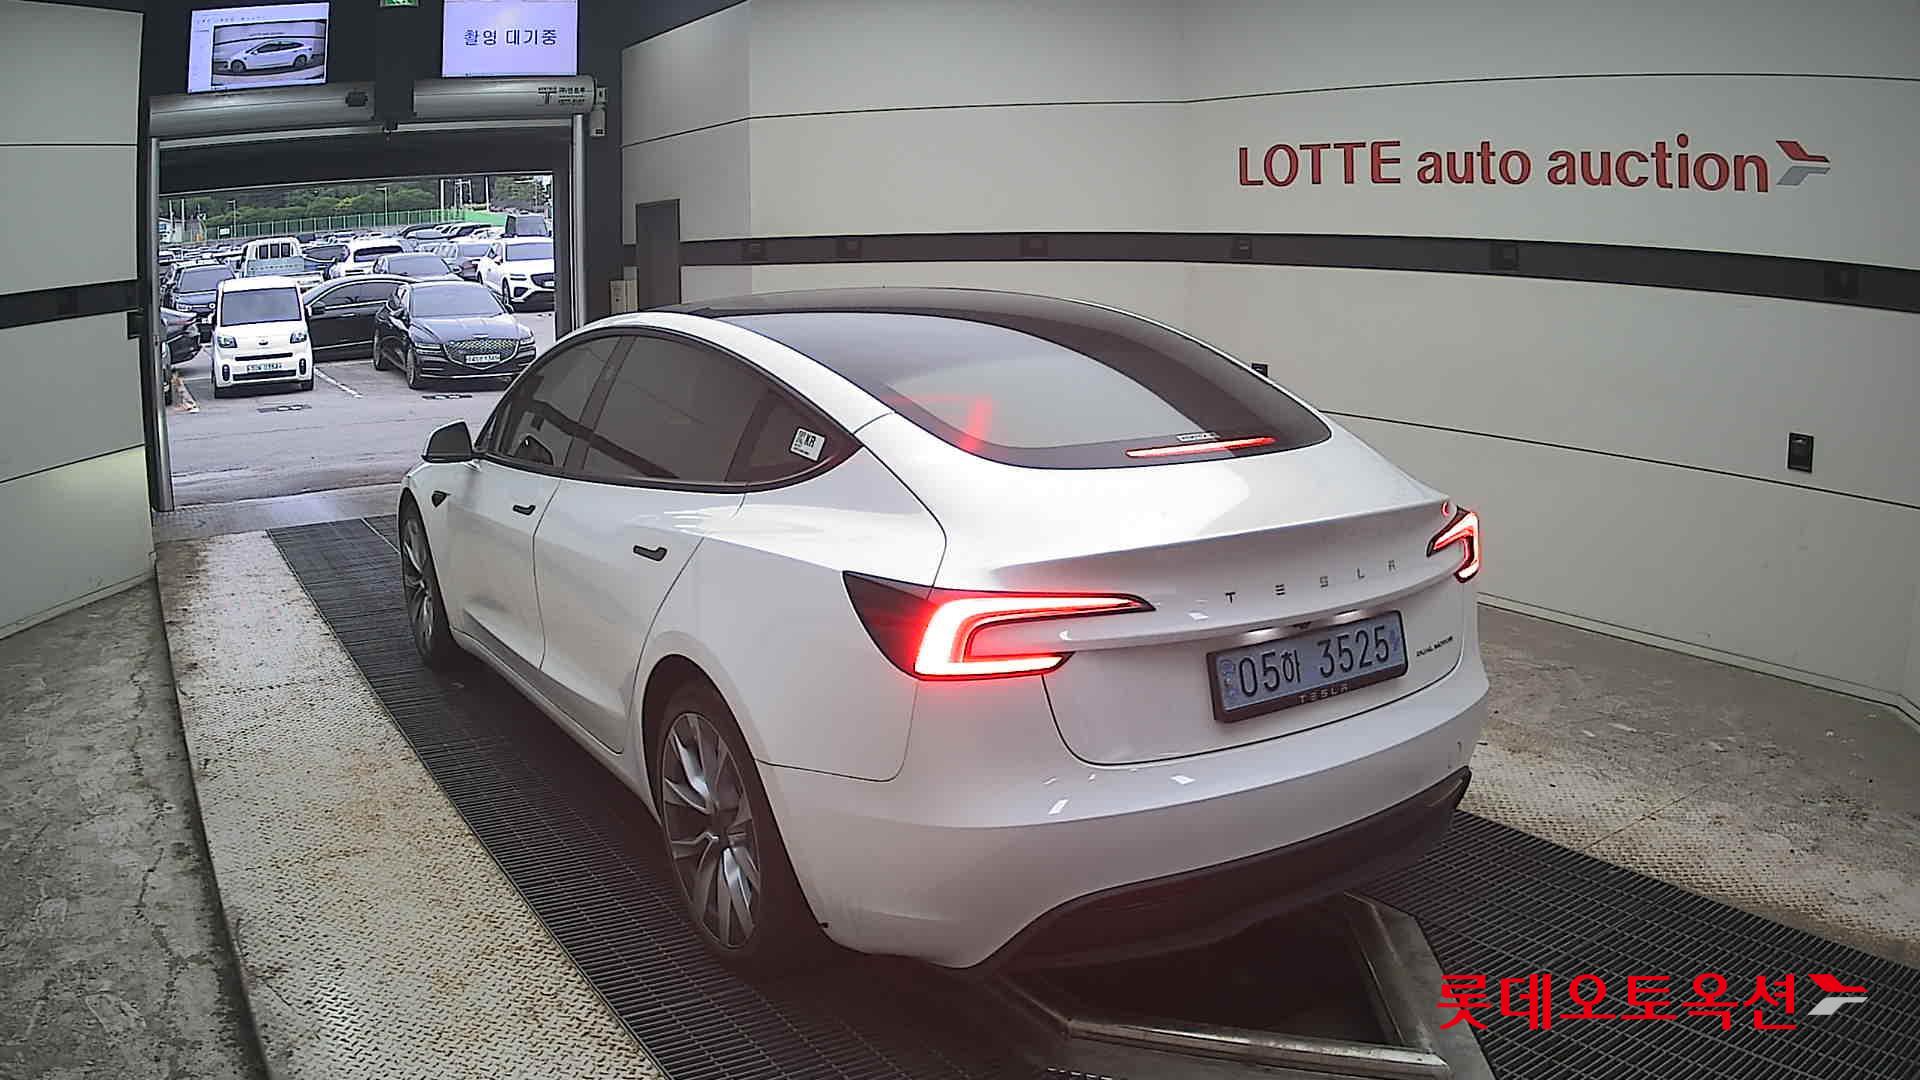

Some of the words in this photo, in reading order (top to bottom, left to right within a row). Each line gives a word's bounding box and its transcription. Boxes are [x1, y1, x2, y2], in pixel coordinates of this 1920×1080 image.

[506, 29, 557, 46] 대기중
[1238, 141, 1402, 187] LOTTE
[1416, 141, 1532, 185] auto
[1546, 133, 1769, 193] auction
[1225, 560, 1397, 604] TESLA
[1238, 648, 1301, 697] 05하
[1318, 625, 1390, 679] 3525
[1299, 684, 1349, 704] TESLA
